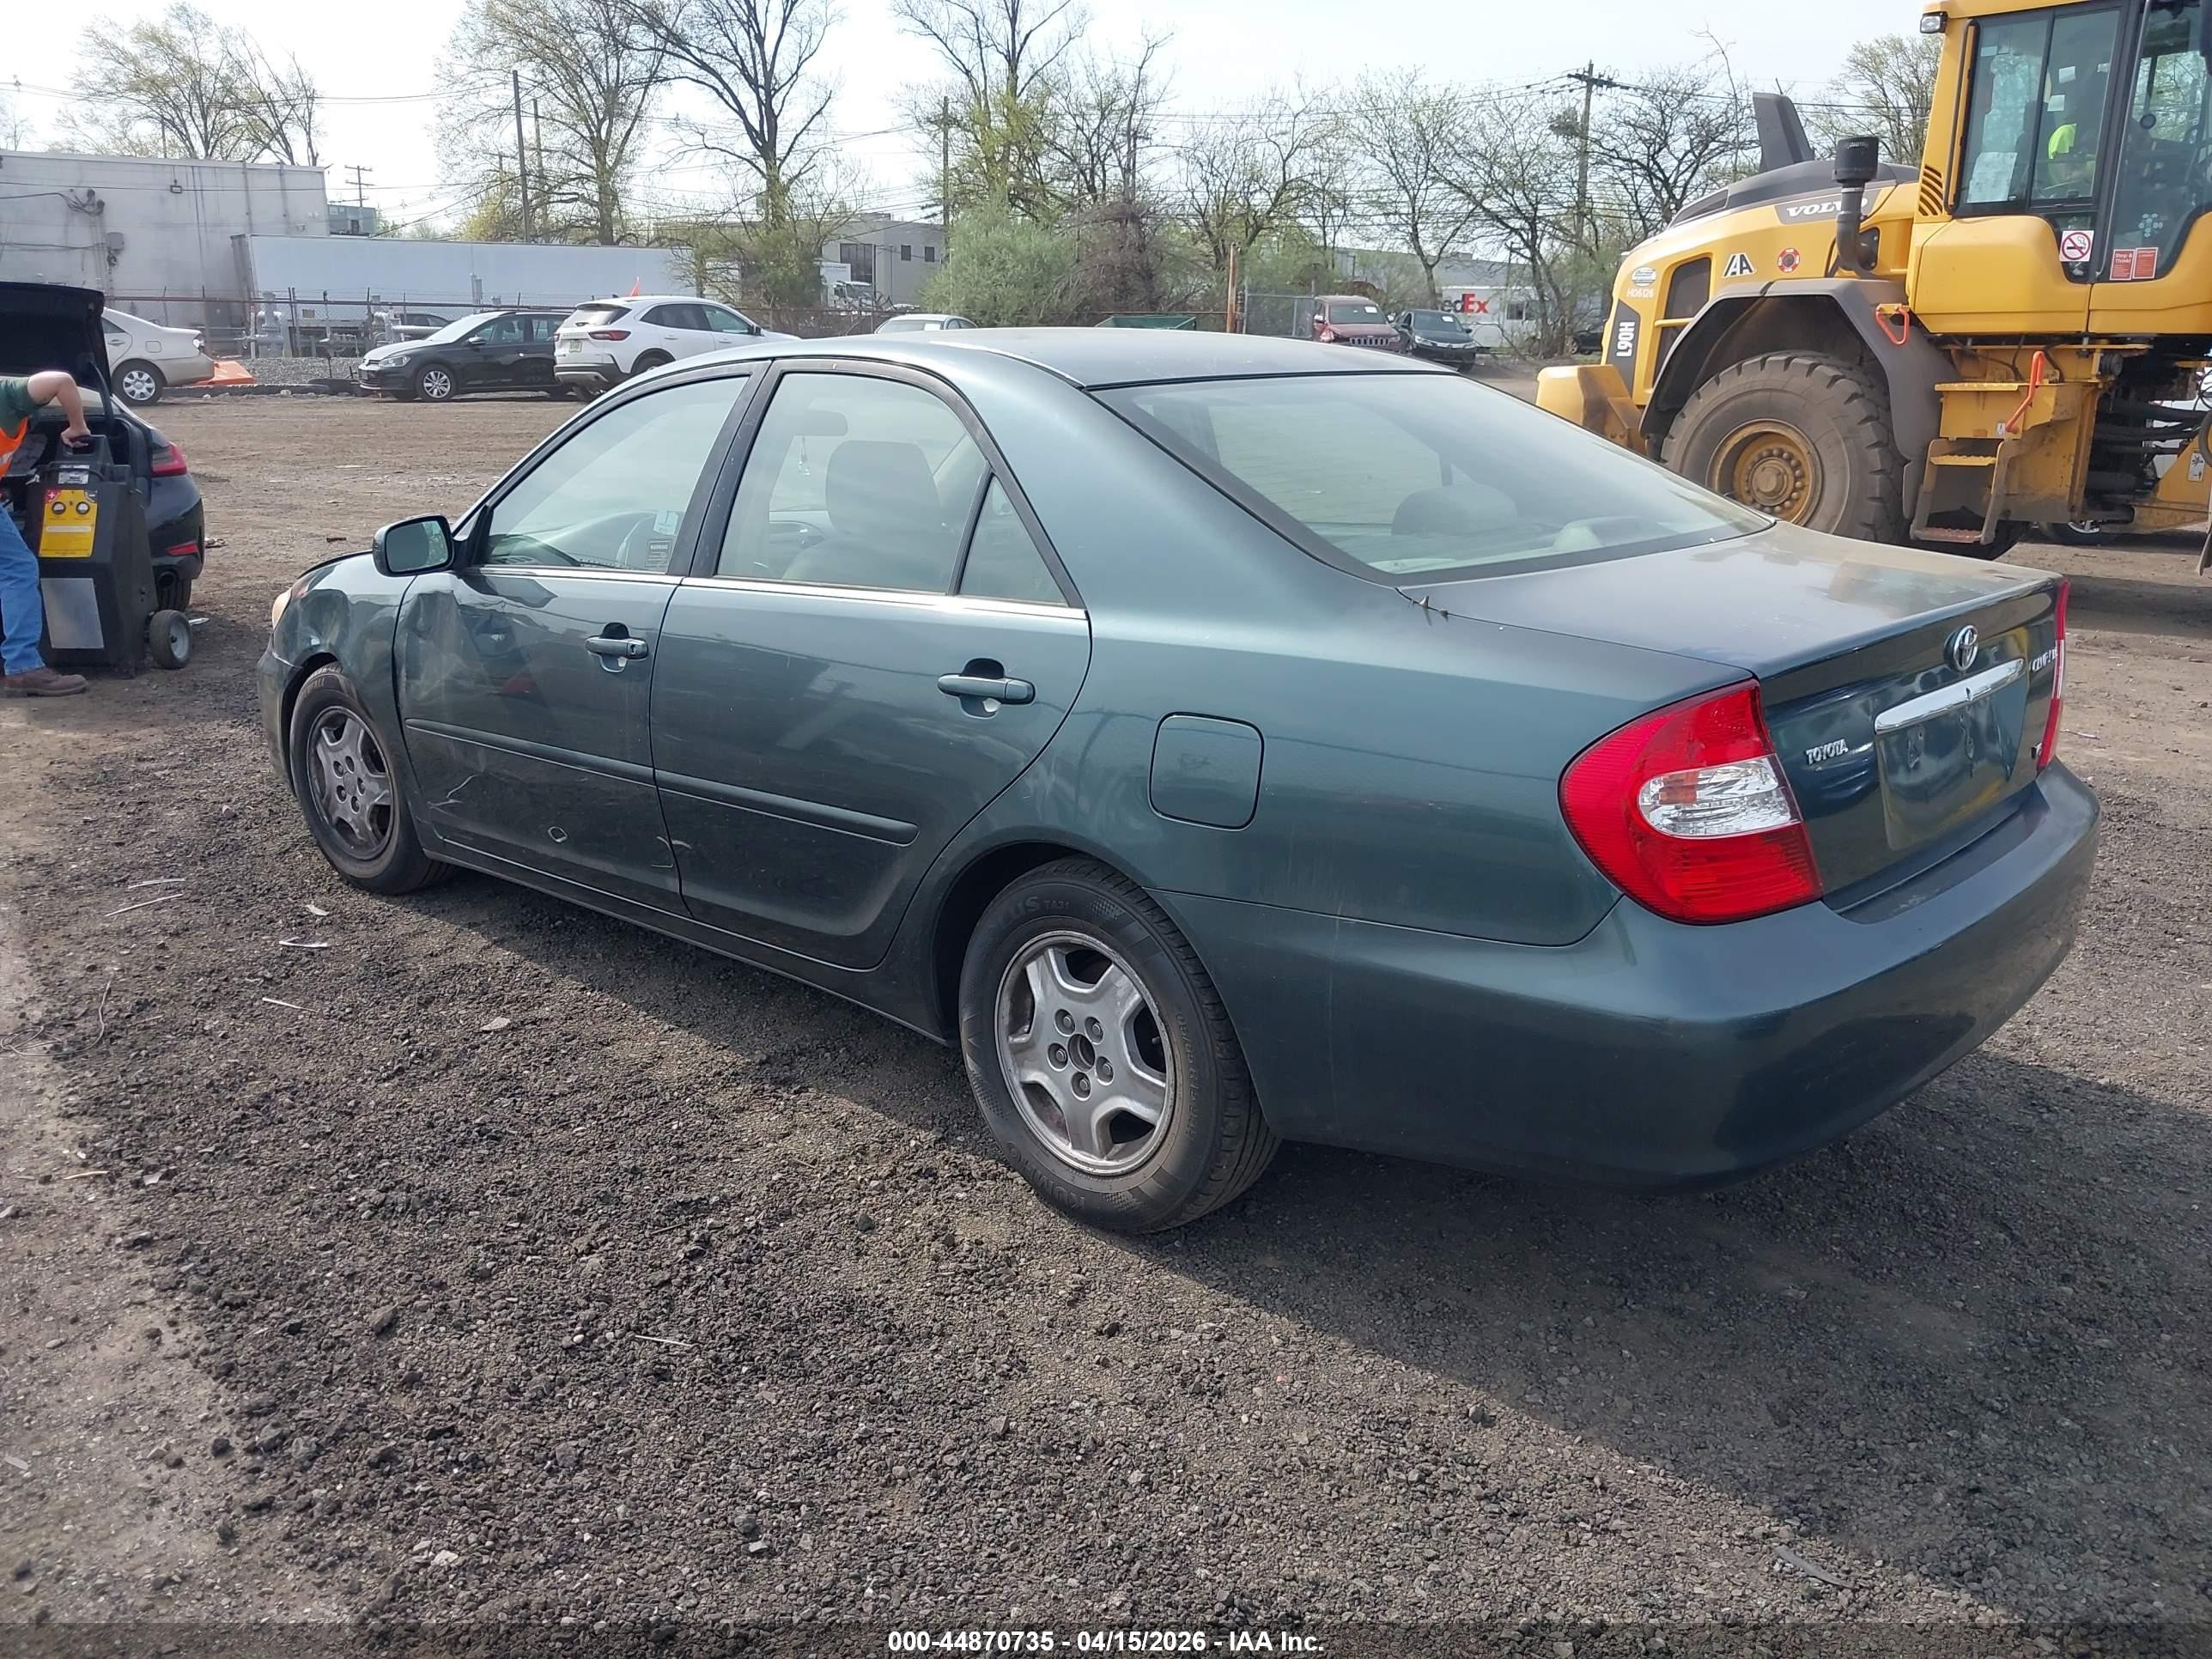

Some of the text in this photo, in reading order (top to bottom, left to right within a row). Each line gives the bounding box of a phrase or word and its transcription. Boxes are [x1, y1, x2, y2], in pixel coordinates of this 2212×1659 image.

[1441, 294, 1489, 313] edEx
[1616, 321, 1635, 357] L90H
[1806, 738, 1849, 764] TOYOTA
